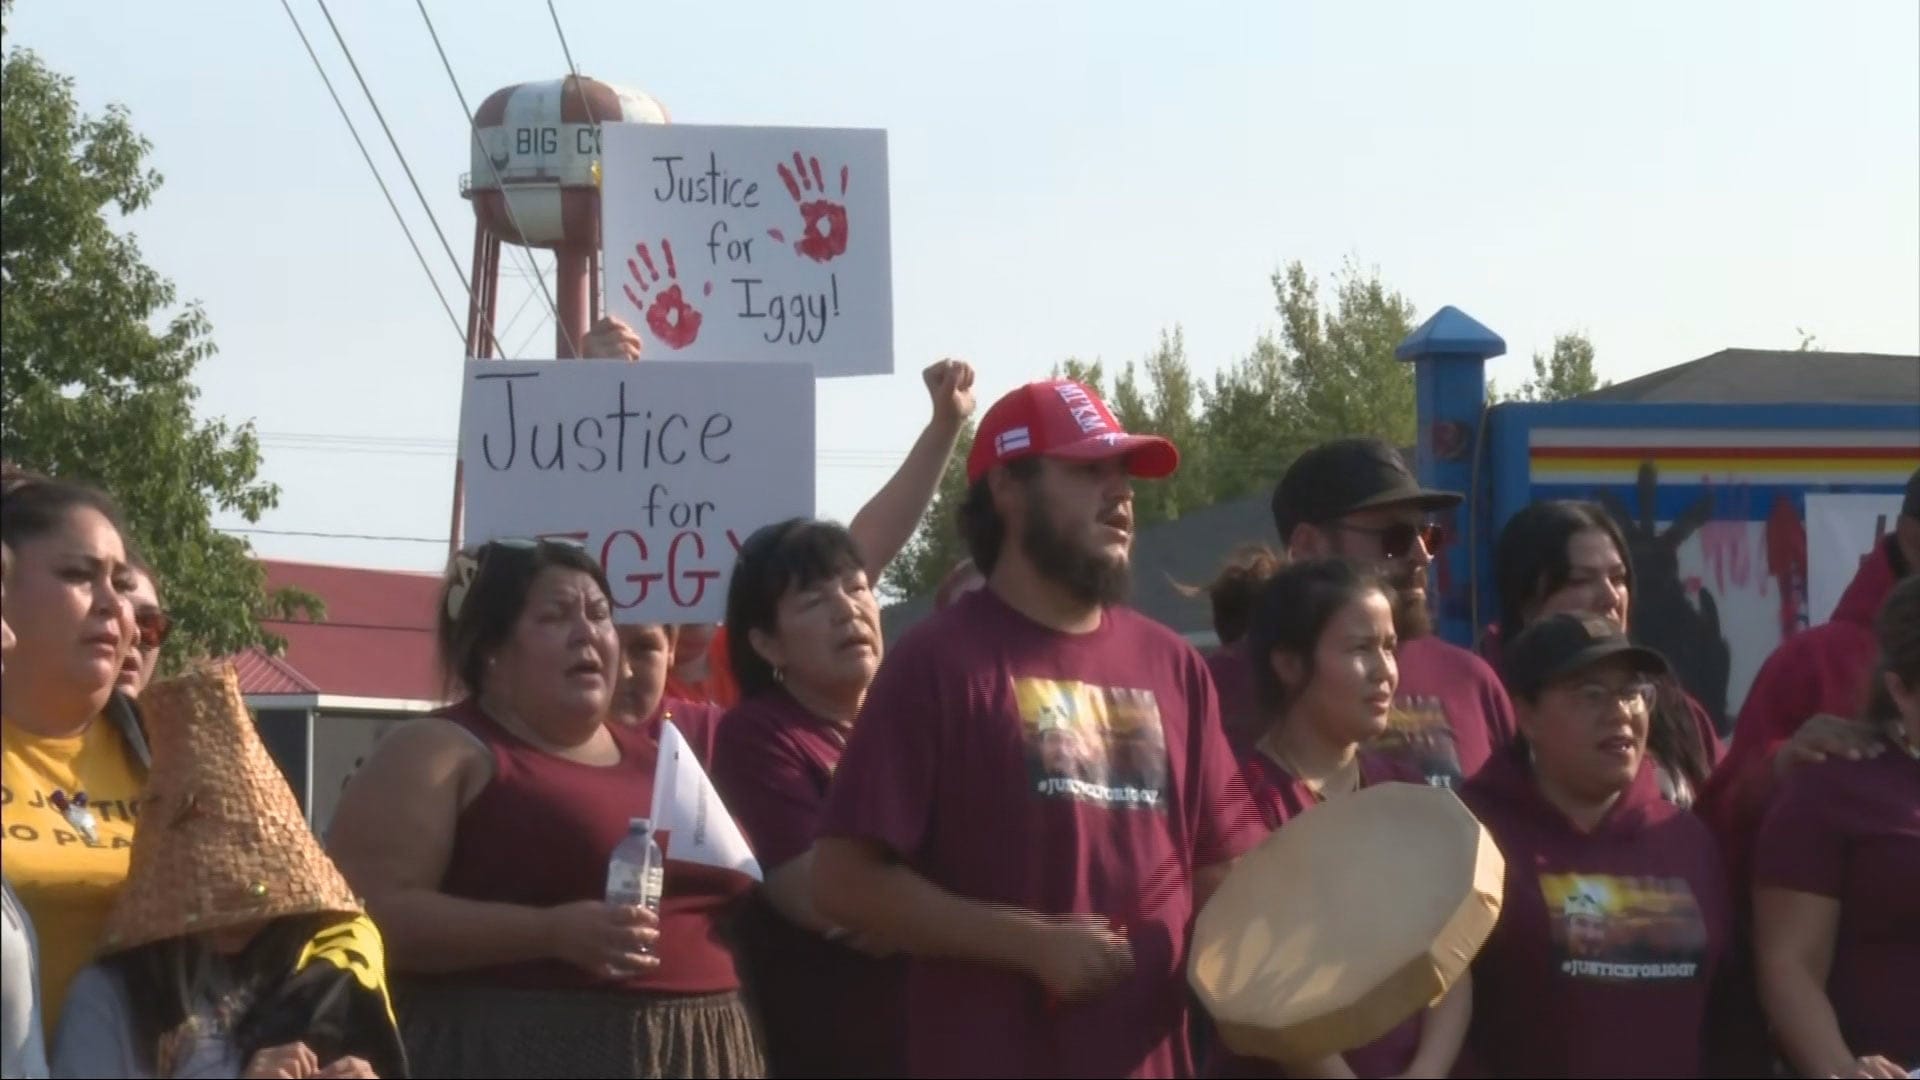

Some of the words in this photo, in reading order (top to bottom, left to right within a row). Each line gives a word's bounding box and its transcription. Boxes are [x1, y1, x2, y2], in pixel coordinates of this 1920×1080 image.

[516, 127, 558, 155] BIG
[652, 151, 760, 208] Justice
[707, 219, 753, 265] for
[731, 273, 841, 345] Iggy!
[475, 372, 733, 472] Justice
[641, 483, 715, 528] for
[534, 529, 743, 609] GG
